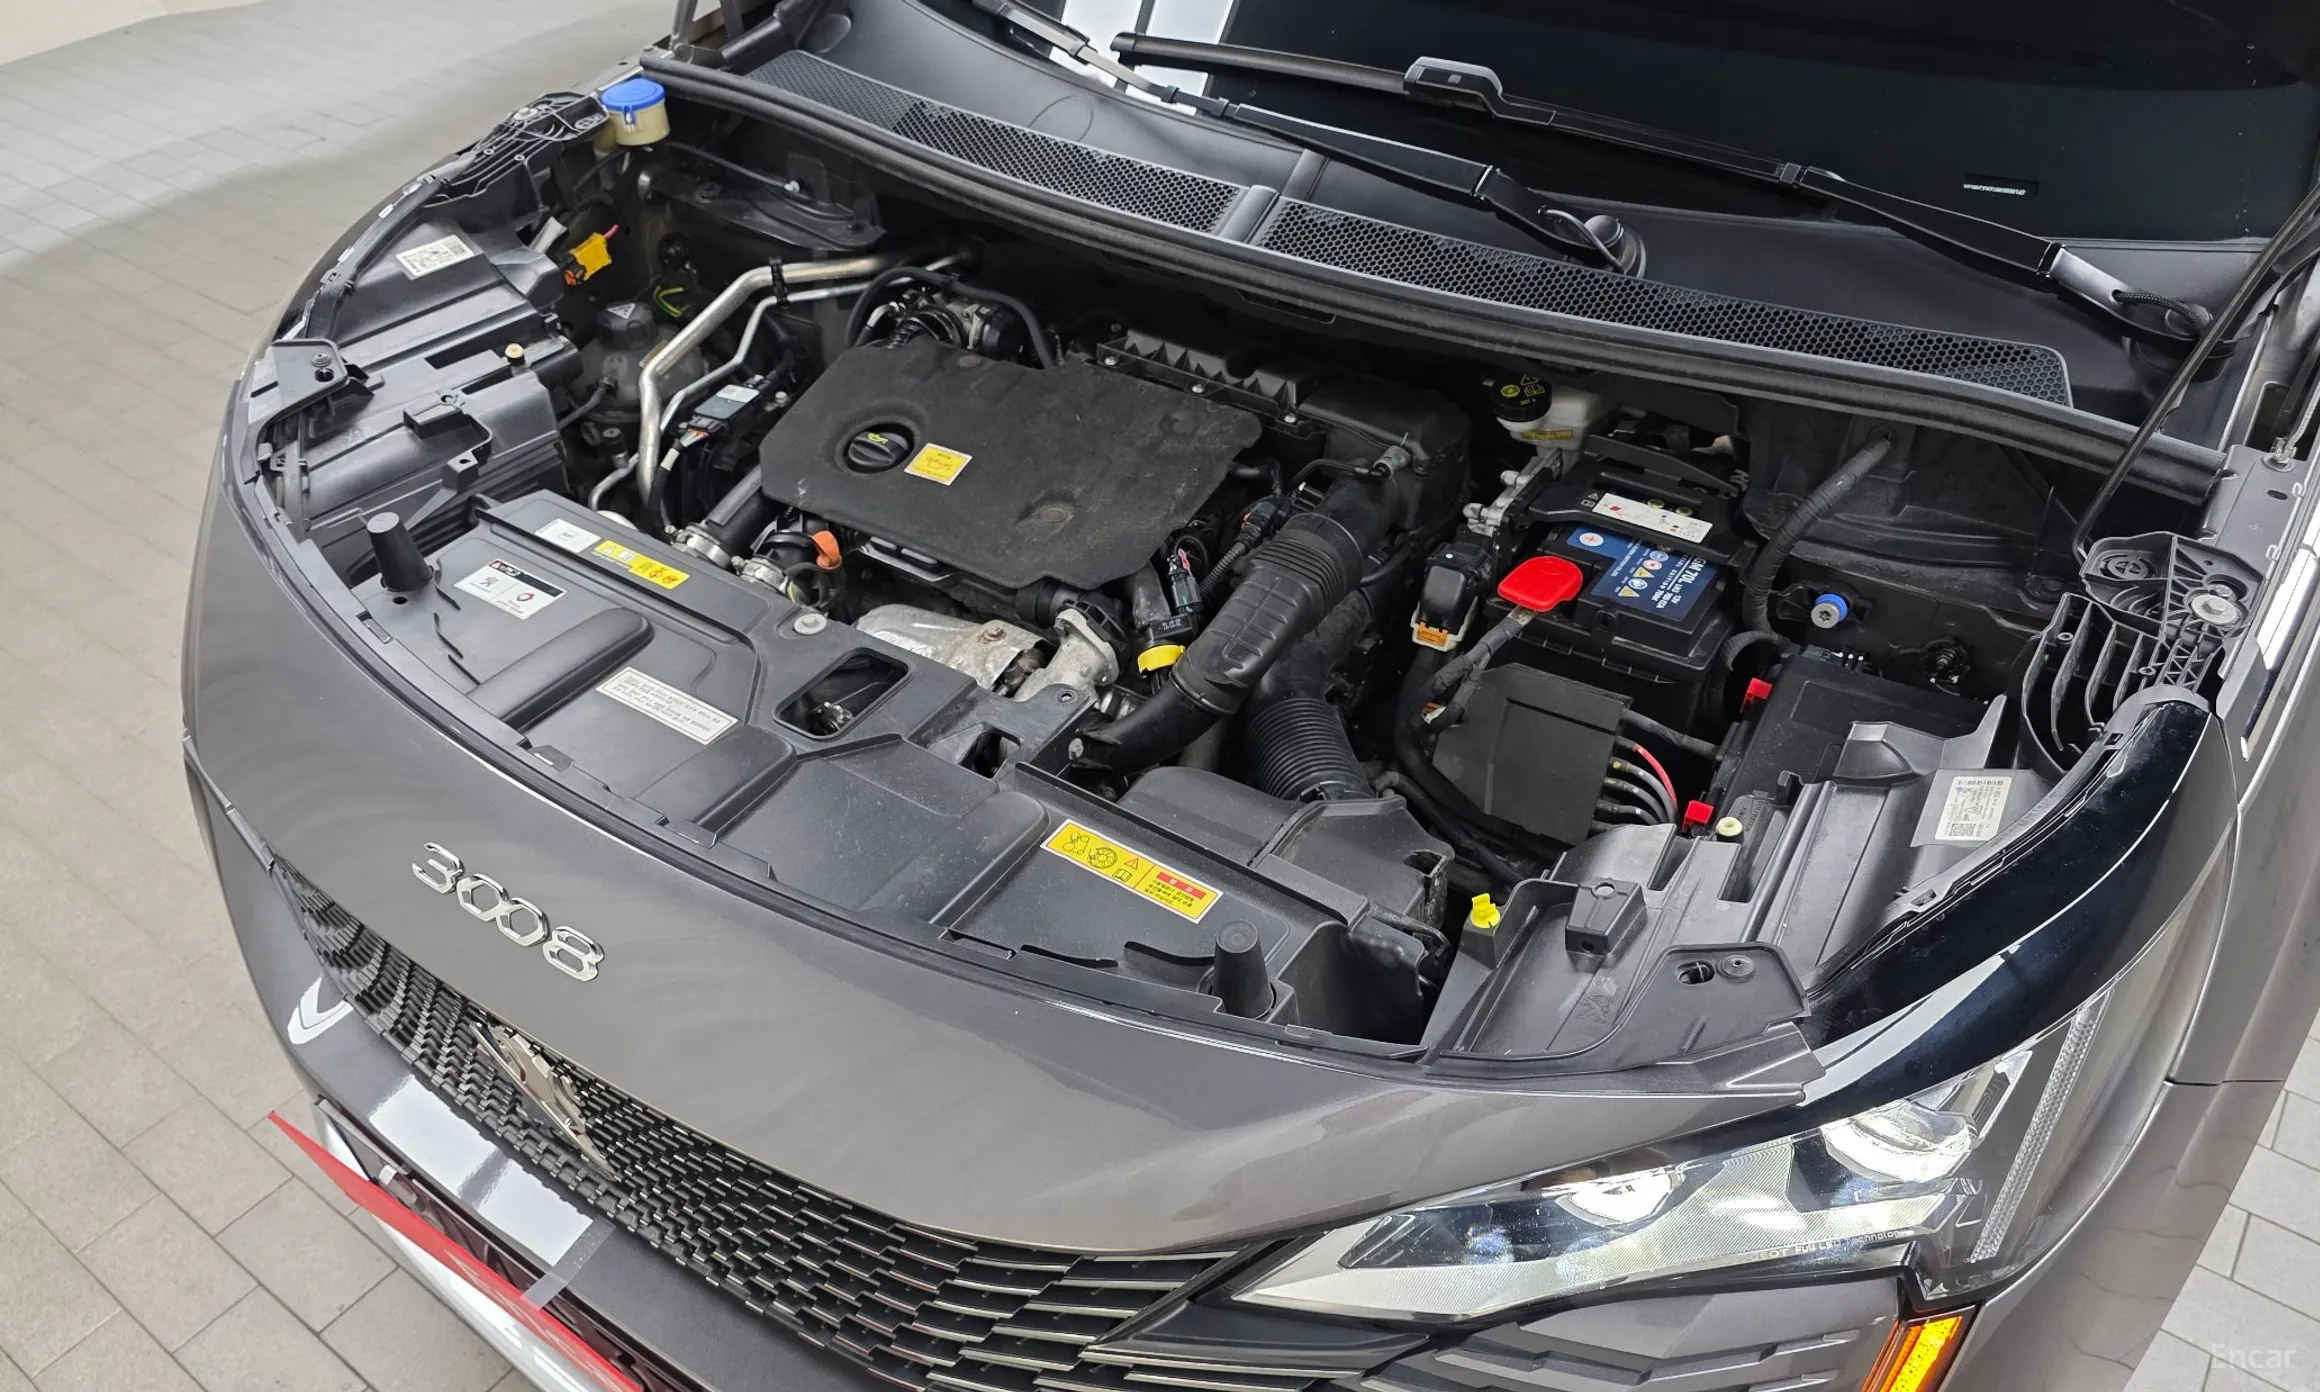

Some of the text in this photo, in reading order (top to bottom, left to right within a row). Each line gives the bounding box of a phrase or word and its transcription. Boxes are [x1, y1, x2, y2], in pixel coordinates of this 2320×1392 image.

[1678, 570, 1699, 584] 70L
[412, 842, 605, 982] 3008
[1795, 1244, 1816, 1254] Full
[1818, 1239, 1841, 1250] LED
